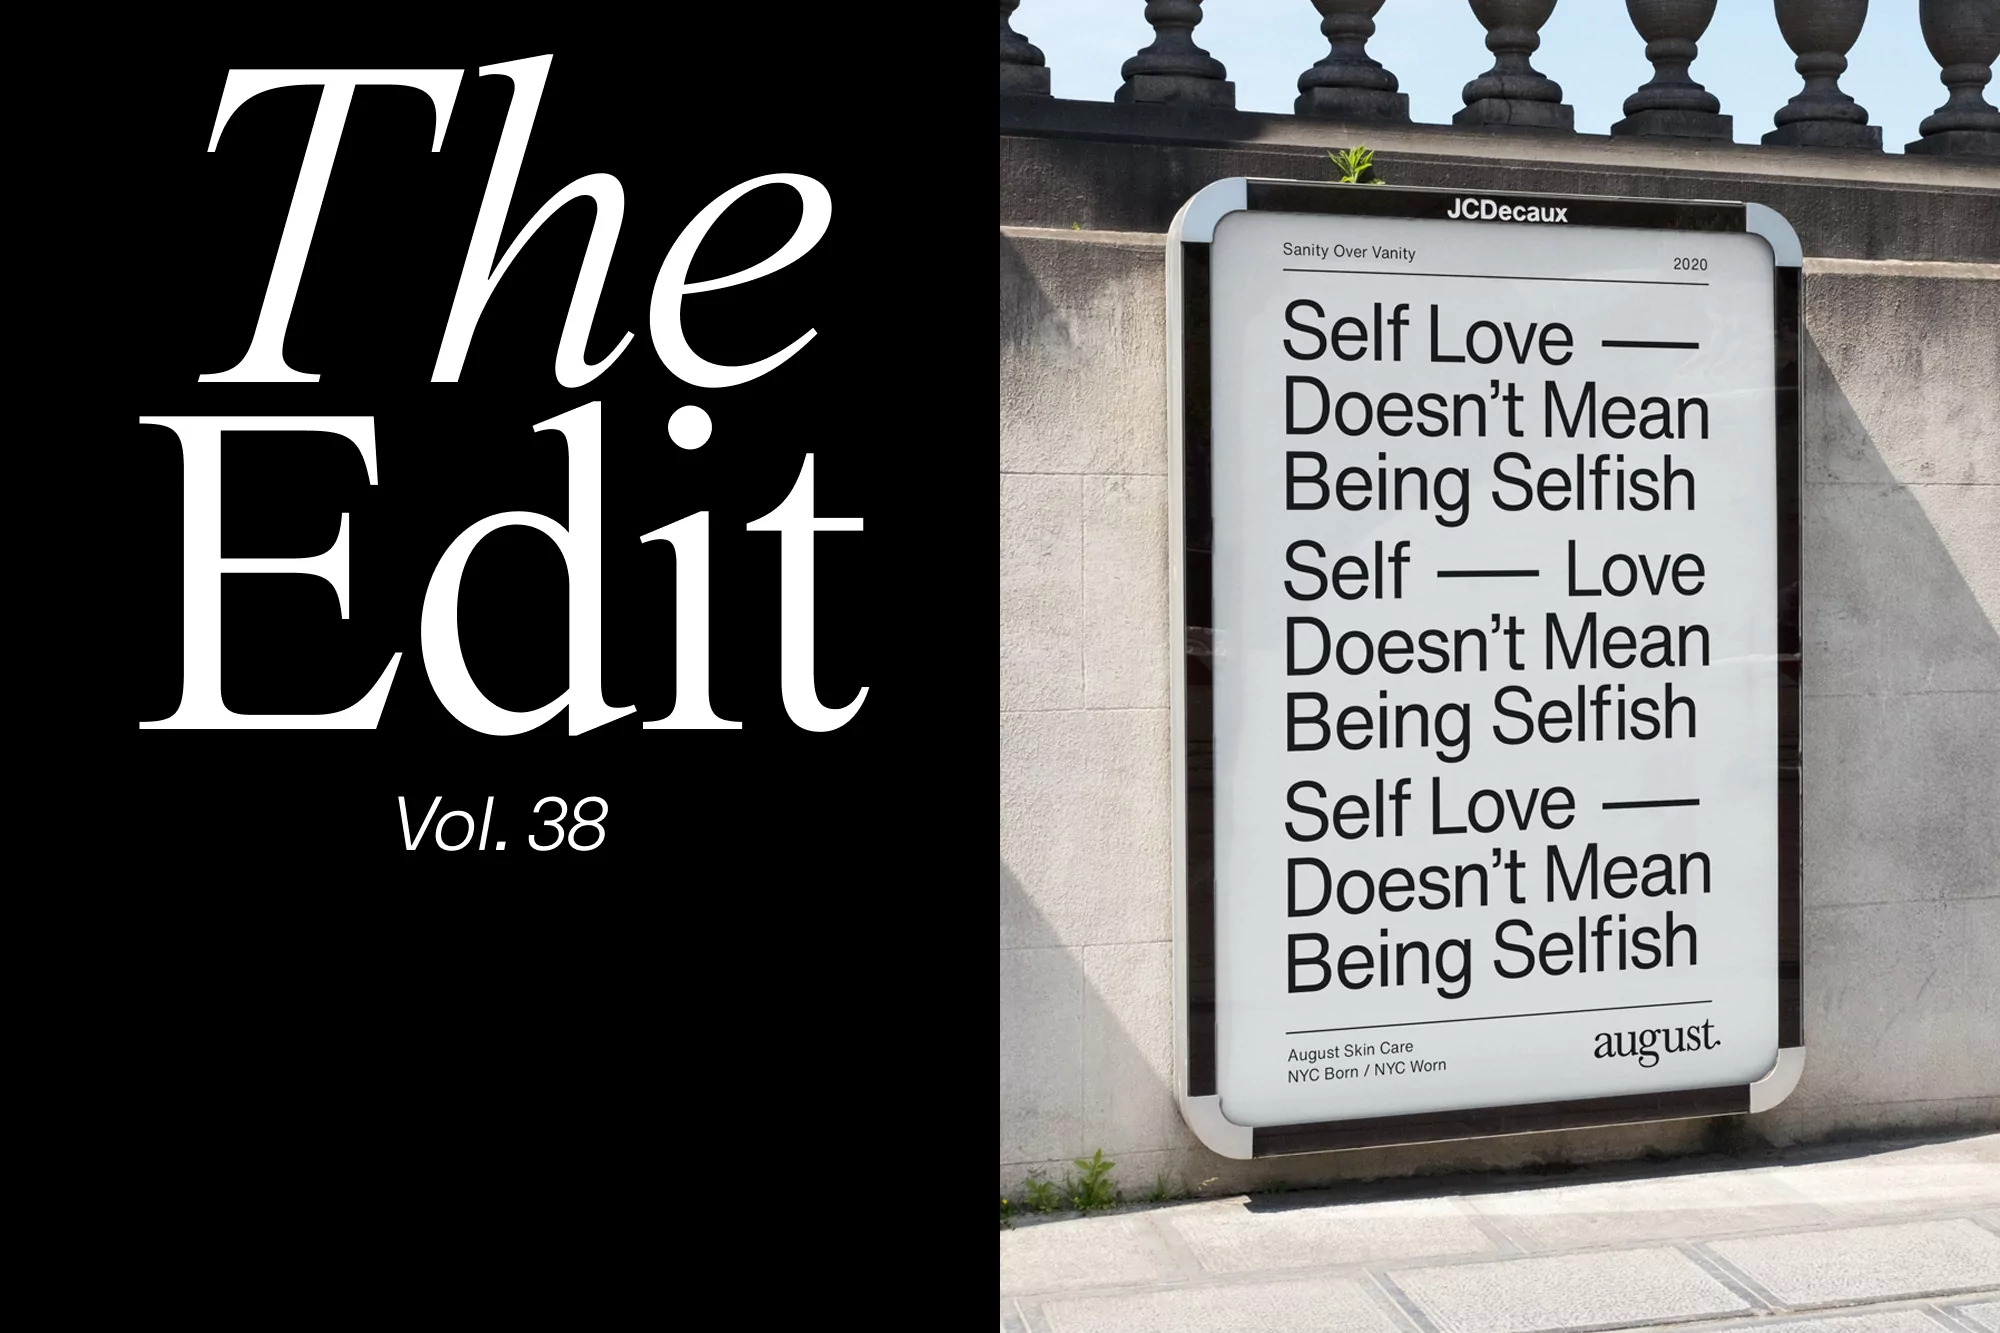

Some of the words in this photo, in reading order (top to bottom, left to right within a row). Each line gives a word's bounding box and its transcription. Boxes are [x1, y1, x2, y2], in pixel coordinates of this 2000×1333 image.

[1446, 197, 1569, 224] JCDecaux
[1283, 241, 1329, 261] Sanity
[1333, 243, 1368, 258] Over
[1371, 245, 1416, 264] Vanity
[1673, 257, 1708, 271] 2020
[1283, 299, 1410, 361] Self
[1430, 303, 1574, 366] Love
[1545, 381, 1709, 440] Mean
[1286, 451, 1470, 528] Being
[1492, 452, 1695, 512] Selfish
[1284, 540, 1411, 602] Self
[1569, 540, 1706, 598] Love
[1546, 611, 1710, 671] Mean
[1287, 690, 1471, 764] Being
[1493, 682, 1696, 746] Selfish
[1285, 777, 1412, 843] Self
[1432, 776, 1576, 835] Love
[1547, 843, 1711, 903] Mean
[1287, 928, 1472, 1000] Being
[1494, 911, 1697, 980] Selfish
[1288, 1046, 1340, 1064] August
[1344, 1042, 1375, 1058] Skin
[1380, 1040, 1414, 1055] Care
[1288, 1067, 1320, 1083] NYC
[1324, 1065, 1359, 1081] Born
[1374, 1061, 1406, 1076] NYC
[1410, 1059, 1447, 1074] Worn
